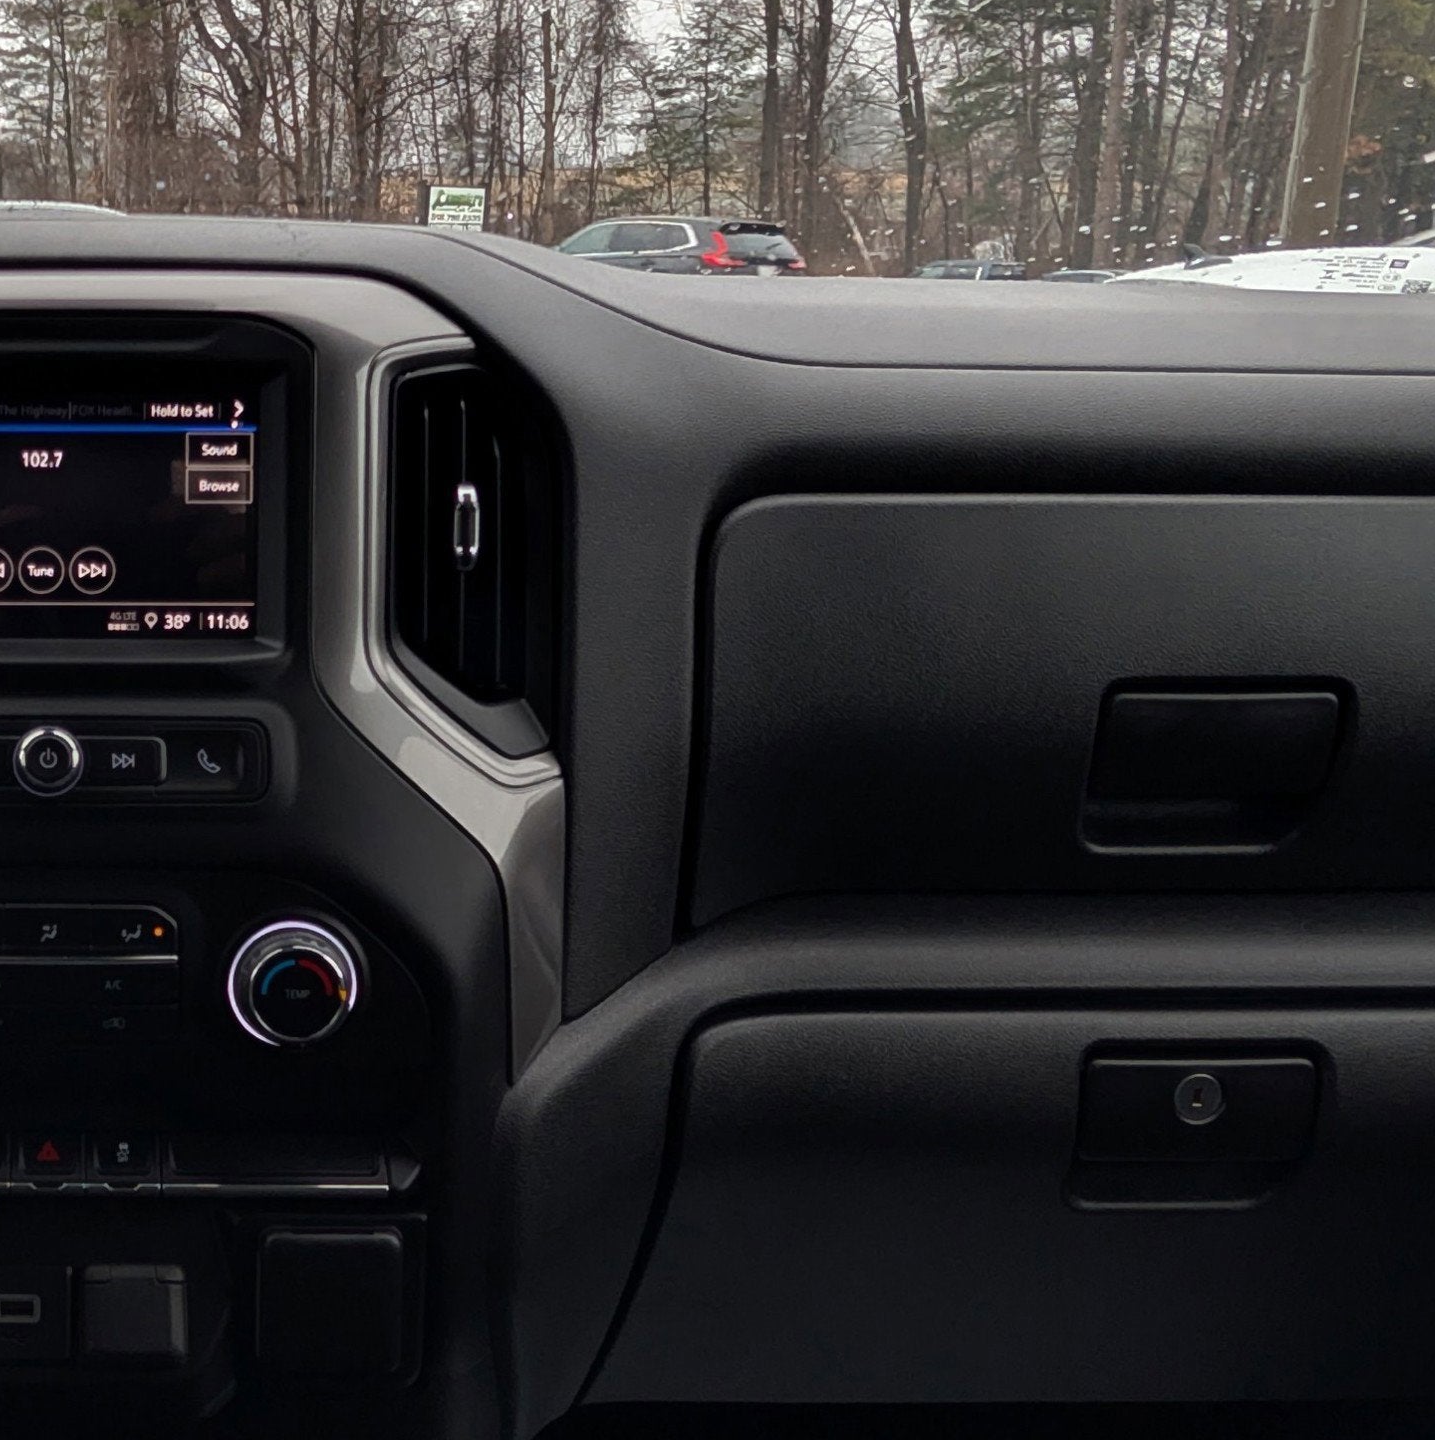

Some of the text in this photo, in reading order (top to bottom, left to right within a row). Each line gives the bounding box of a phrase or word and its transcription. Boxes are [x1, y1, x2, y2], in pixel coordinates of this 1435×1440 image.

[150, 403, 215, 418] Hold to Set
[201, 442, 238, 457] Sound
[21, 450, 64, 469] 102.7
[198, 478, 240, 494] Browse
[27, 565, 55, 578] Tune
[206, 613, 249, 630] 11:06
[104, 979, 123, 991] A/C
[284, 988, 311, 1000] TEMP
